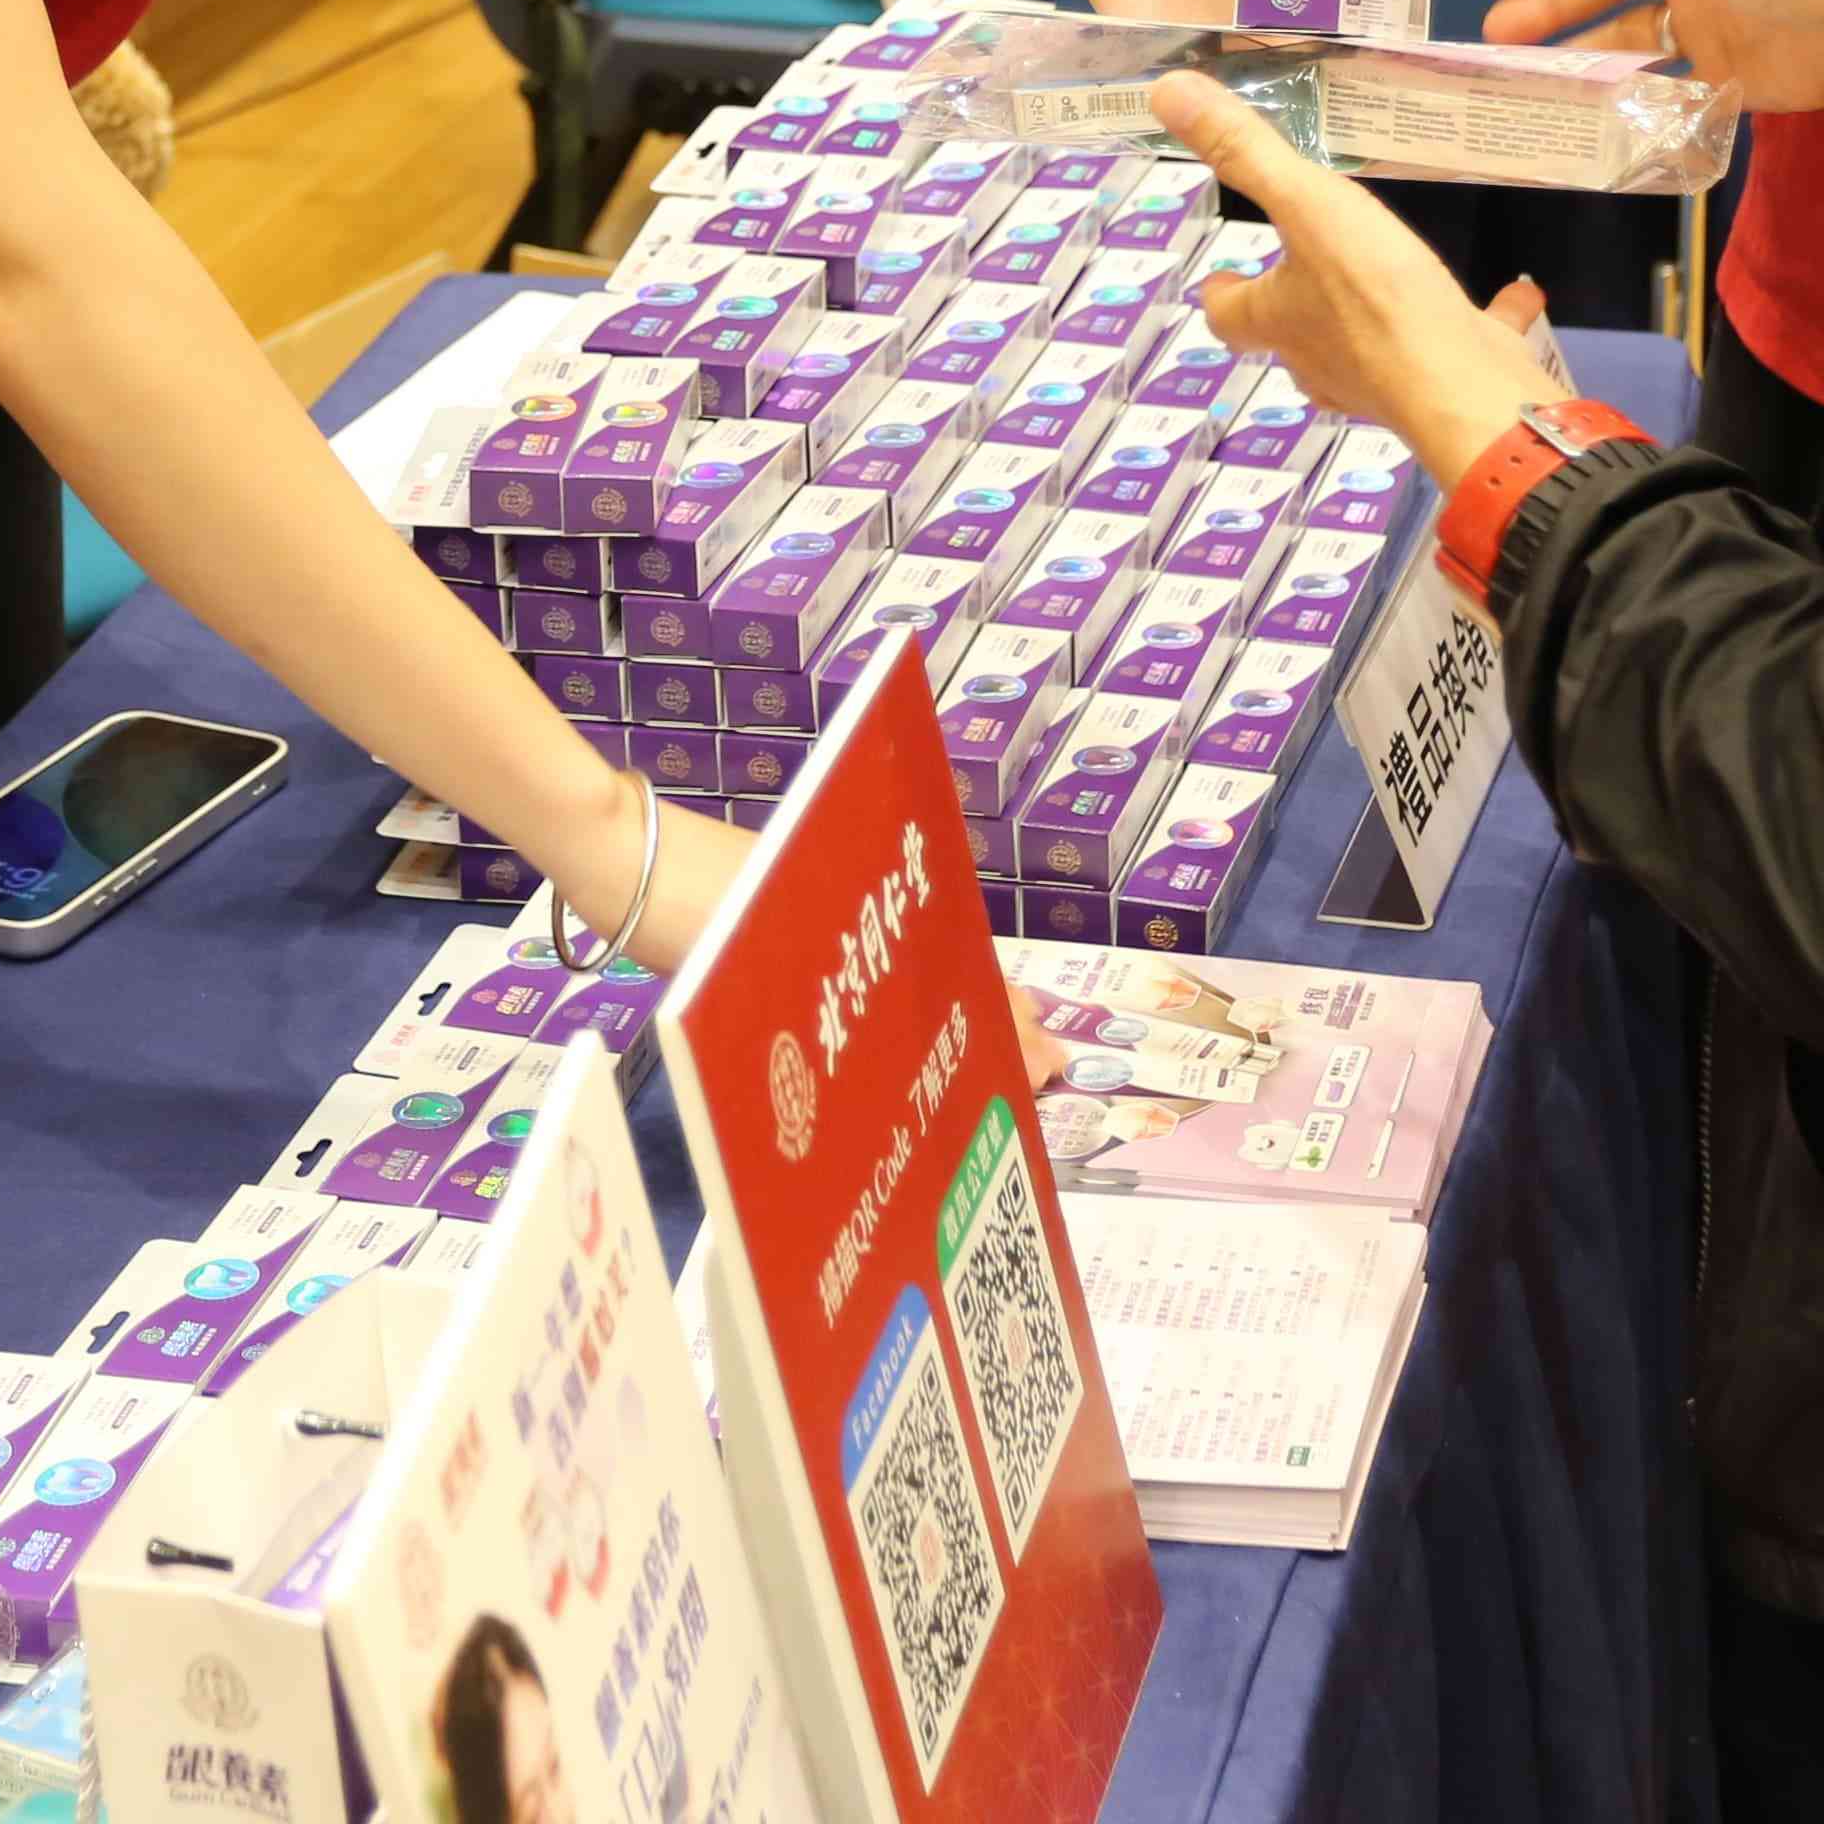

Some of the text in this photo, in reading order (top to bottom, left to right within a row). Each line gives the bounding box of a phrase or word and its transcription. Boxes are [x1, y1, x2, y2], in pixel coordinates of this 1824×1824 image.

[818, 821, 931, 1078] 北京同仁堂
[873, 1127, 912, 1207] Code
[908, 1000, 968, 1137] 了解更多
[851, 1314, 914, 1451] Facebook
